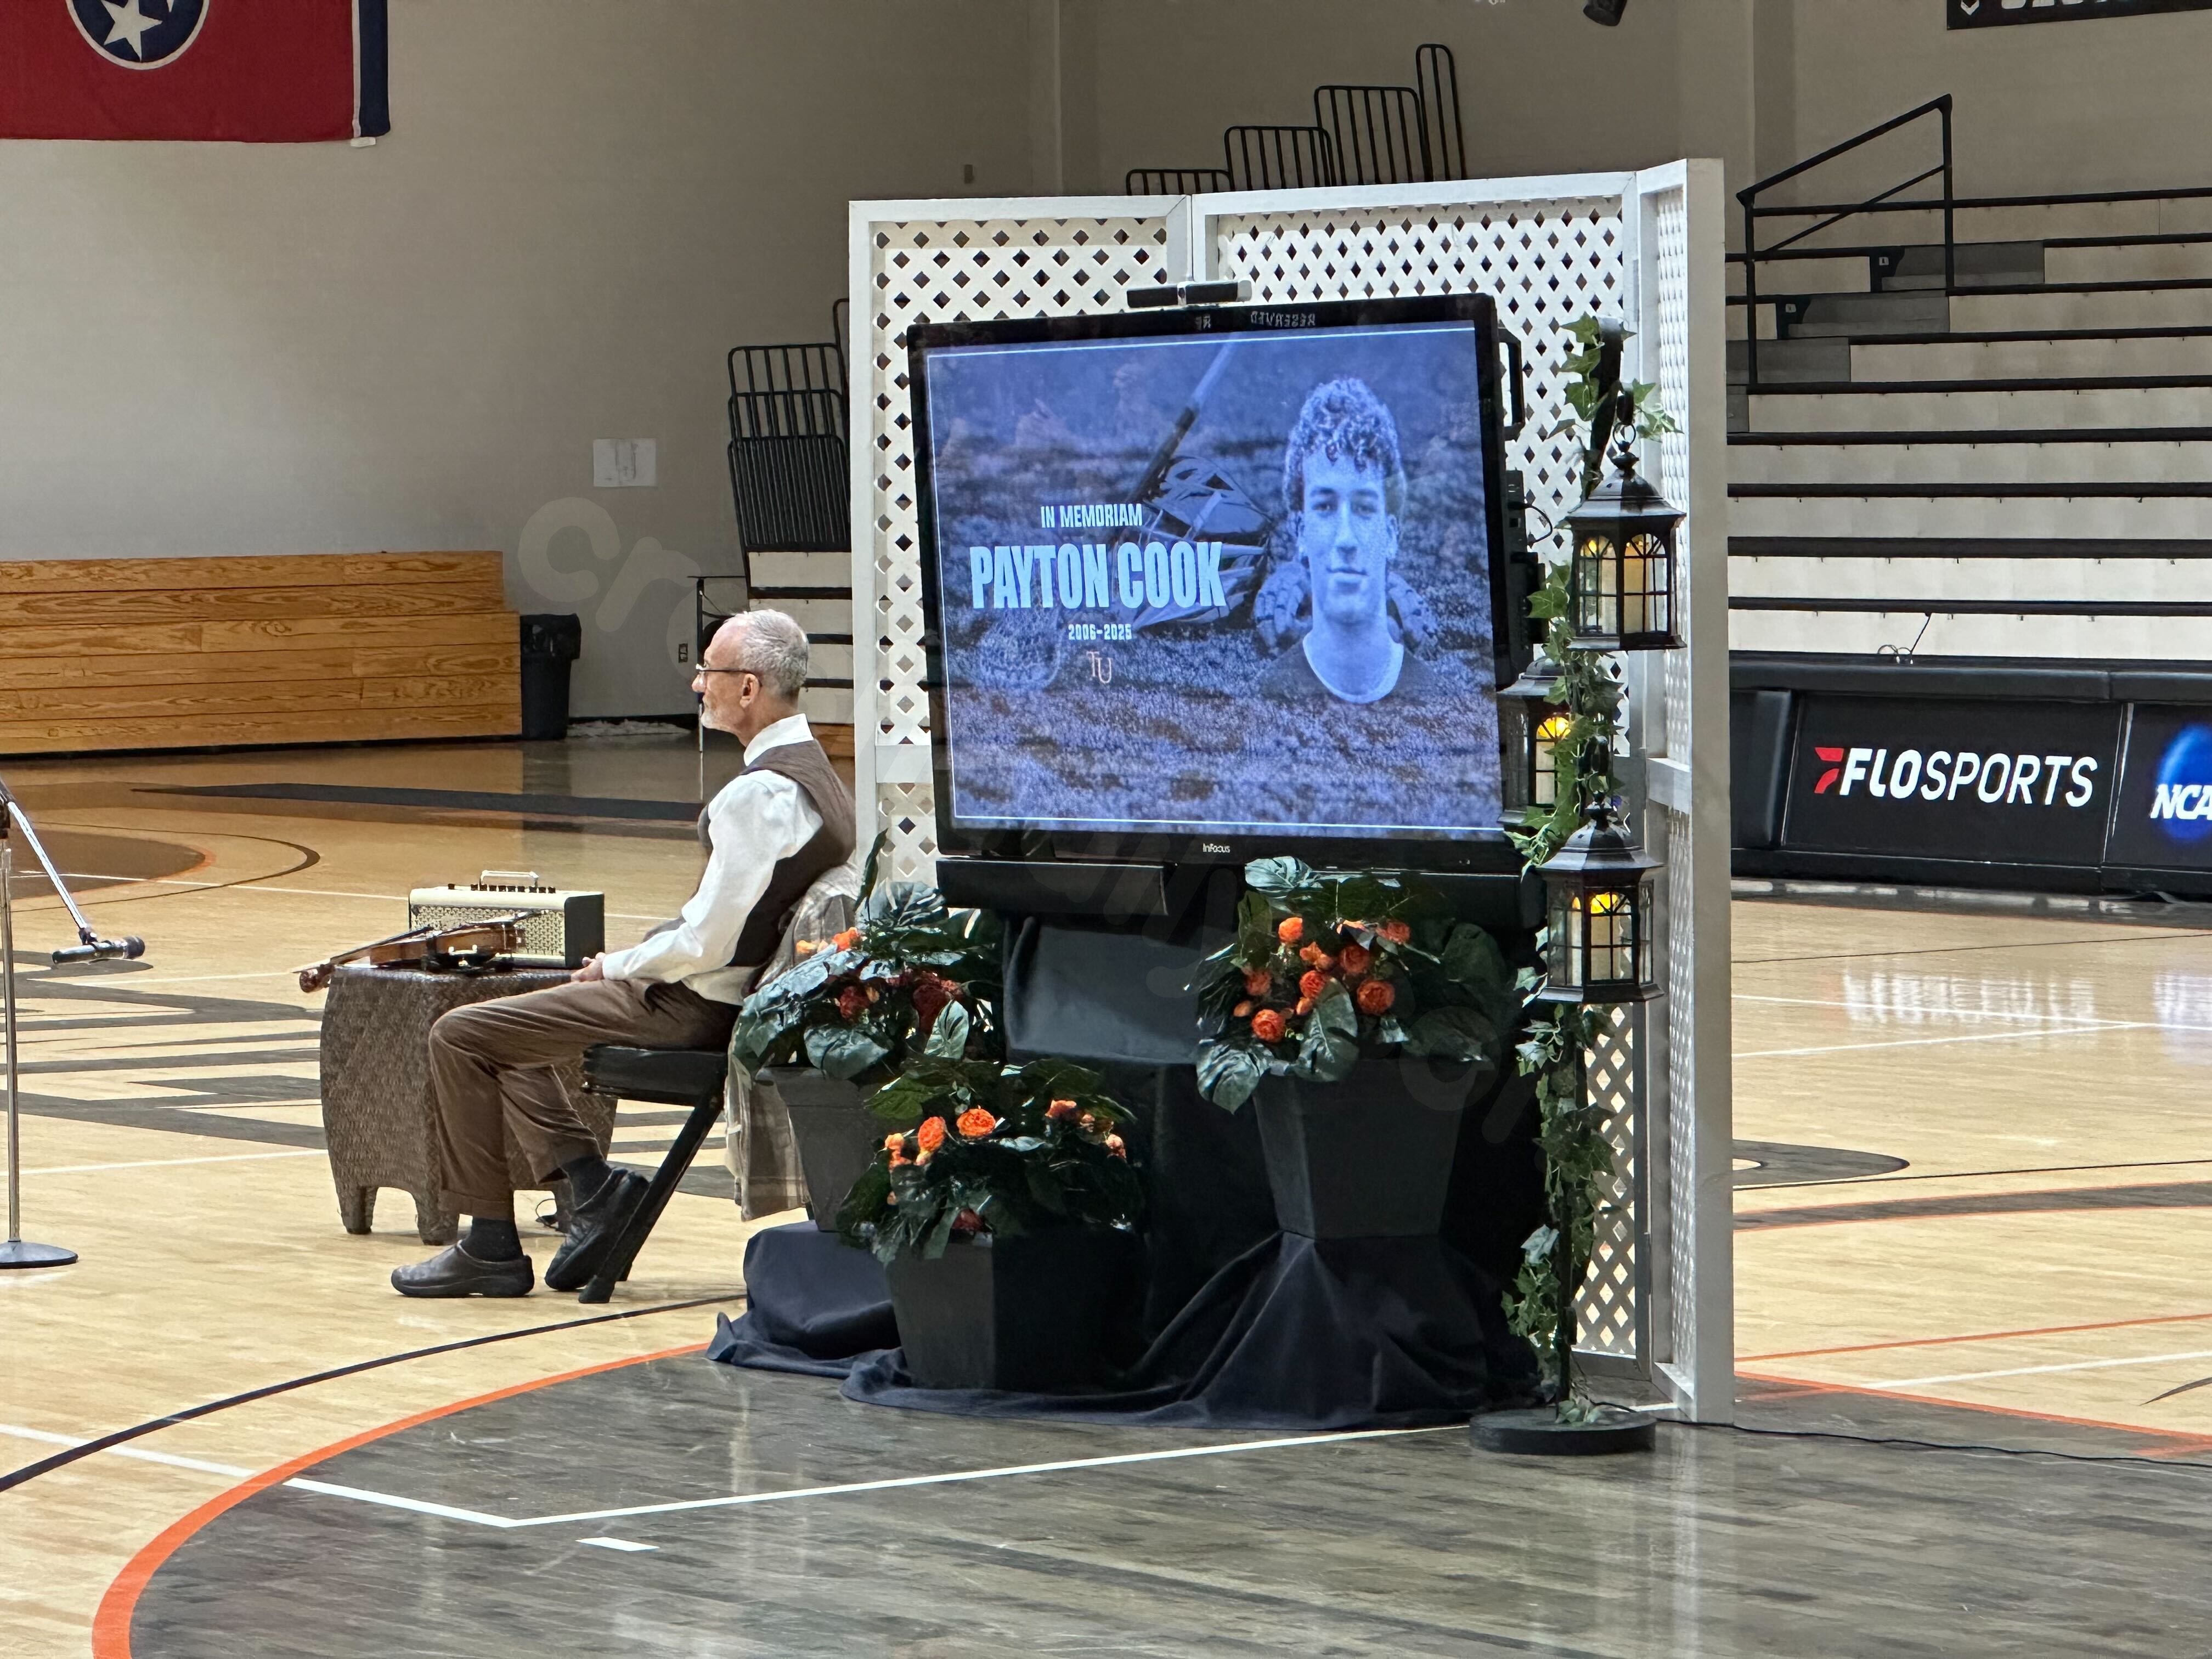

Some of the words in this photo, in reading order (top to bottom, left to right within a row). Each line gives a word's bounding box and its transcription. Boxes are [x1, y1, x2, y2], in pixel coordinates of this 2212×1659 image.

[1041, 506, 1055, 528] IN
[1060, 504, 1142, 527] MEMORIAM
[969, 543, 1109, 609] PAYTON
[1117, 541, 1227, 608] COOK
[1068, 624, 1132, 640] 2006-2025
[1086, 651, 1112, 684] TU
[1839, 748, 2098, 808] FLOSPORTS
